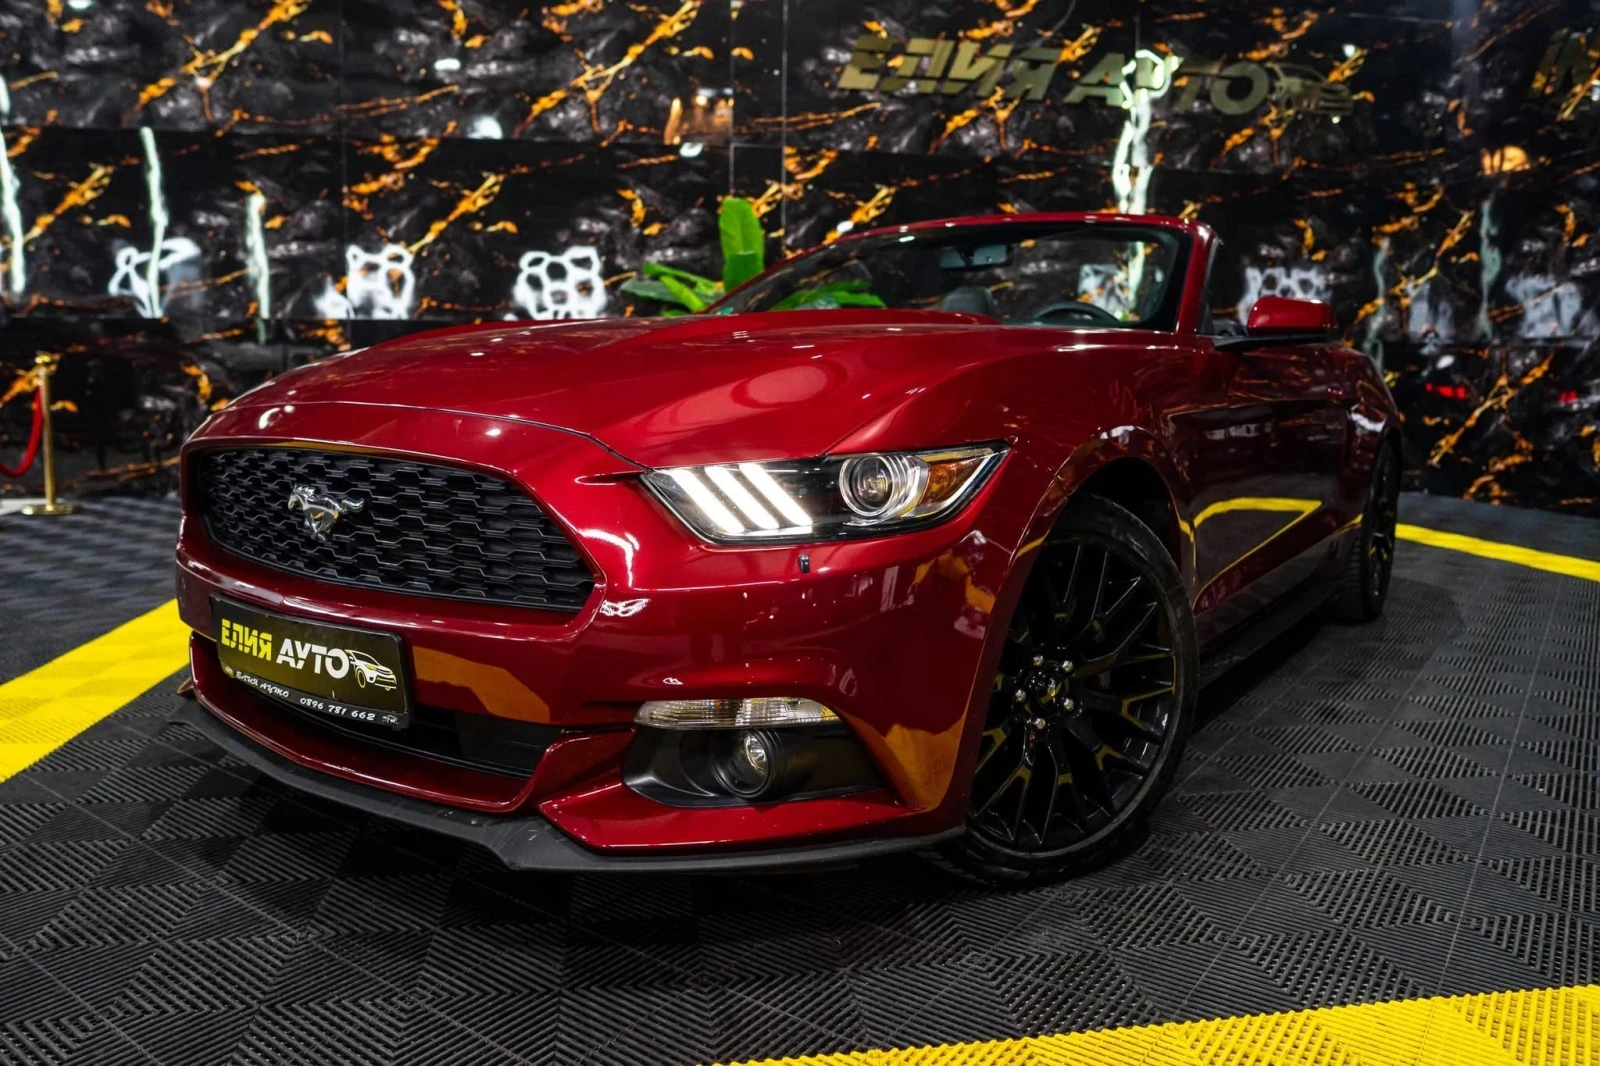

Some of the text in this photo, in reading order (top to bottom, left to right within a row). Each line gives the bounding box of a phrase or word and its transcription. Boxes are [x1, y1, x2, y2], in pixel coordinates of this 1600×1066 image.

[838, 34, 1064, 101] ЕЛИЯ
[221, 618, 350, 679] ЕЛИЯ АУТО
[300, 697, 324, 710] 0896
[328, 704, 347, 715] 781
[351, 709, 376, 721] 662
